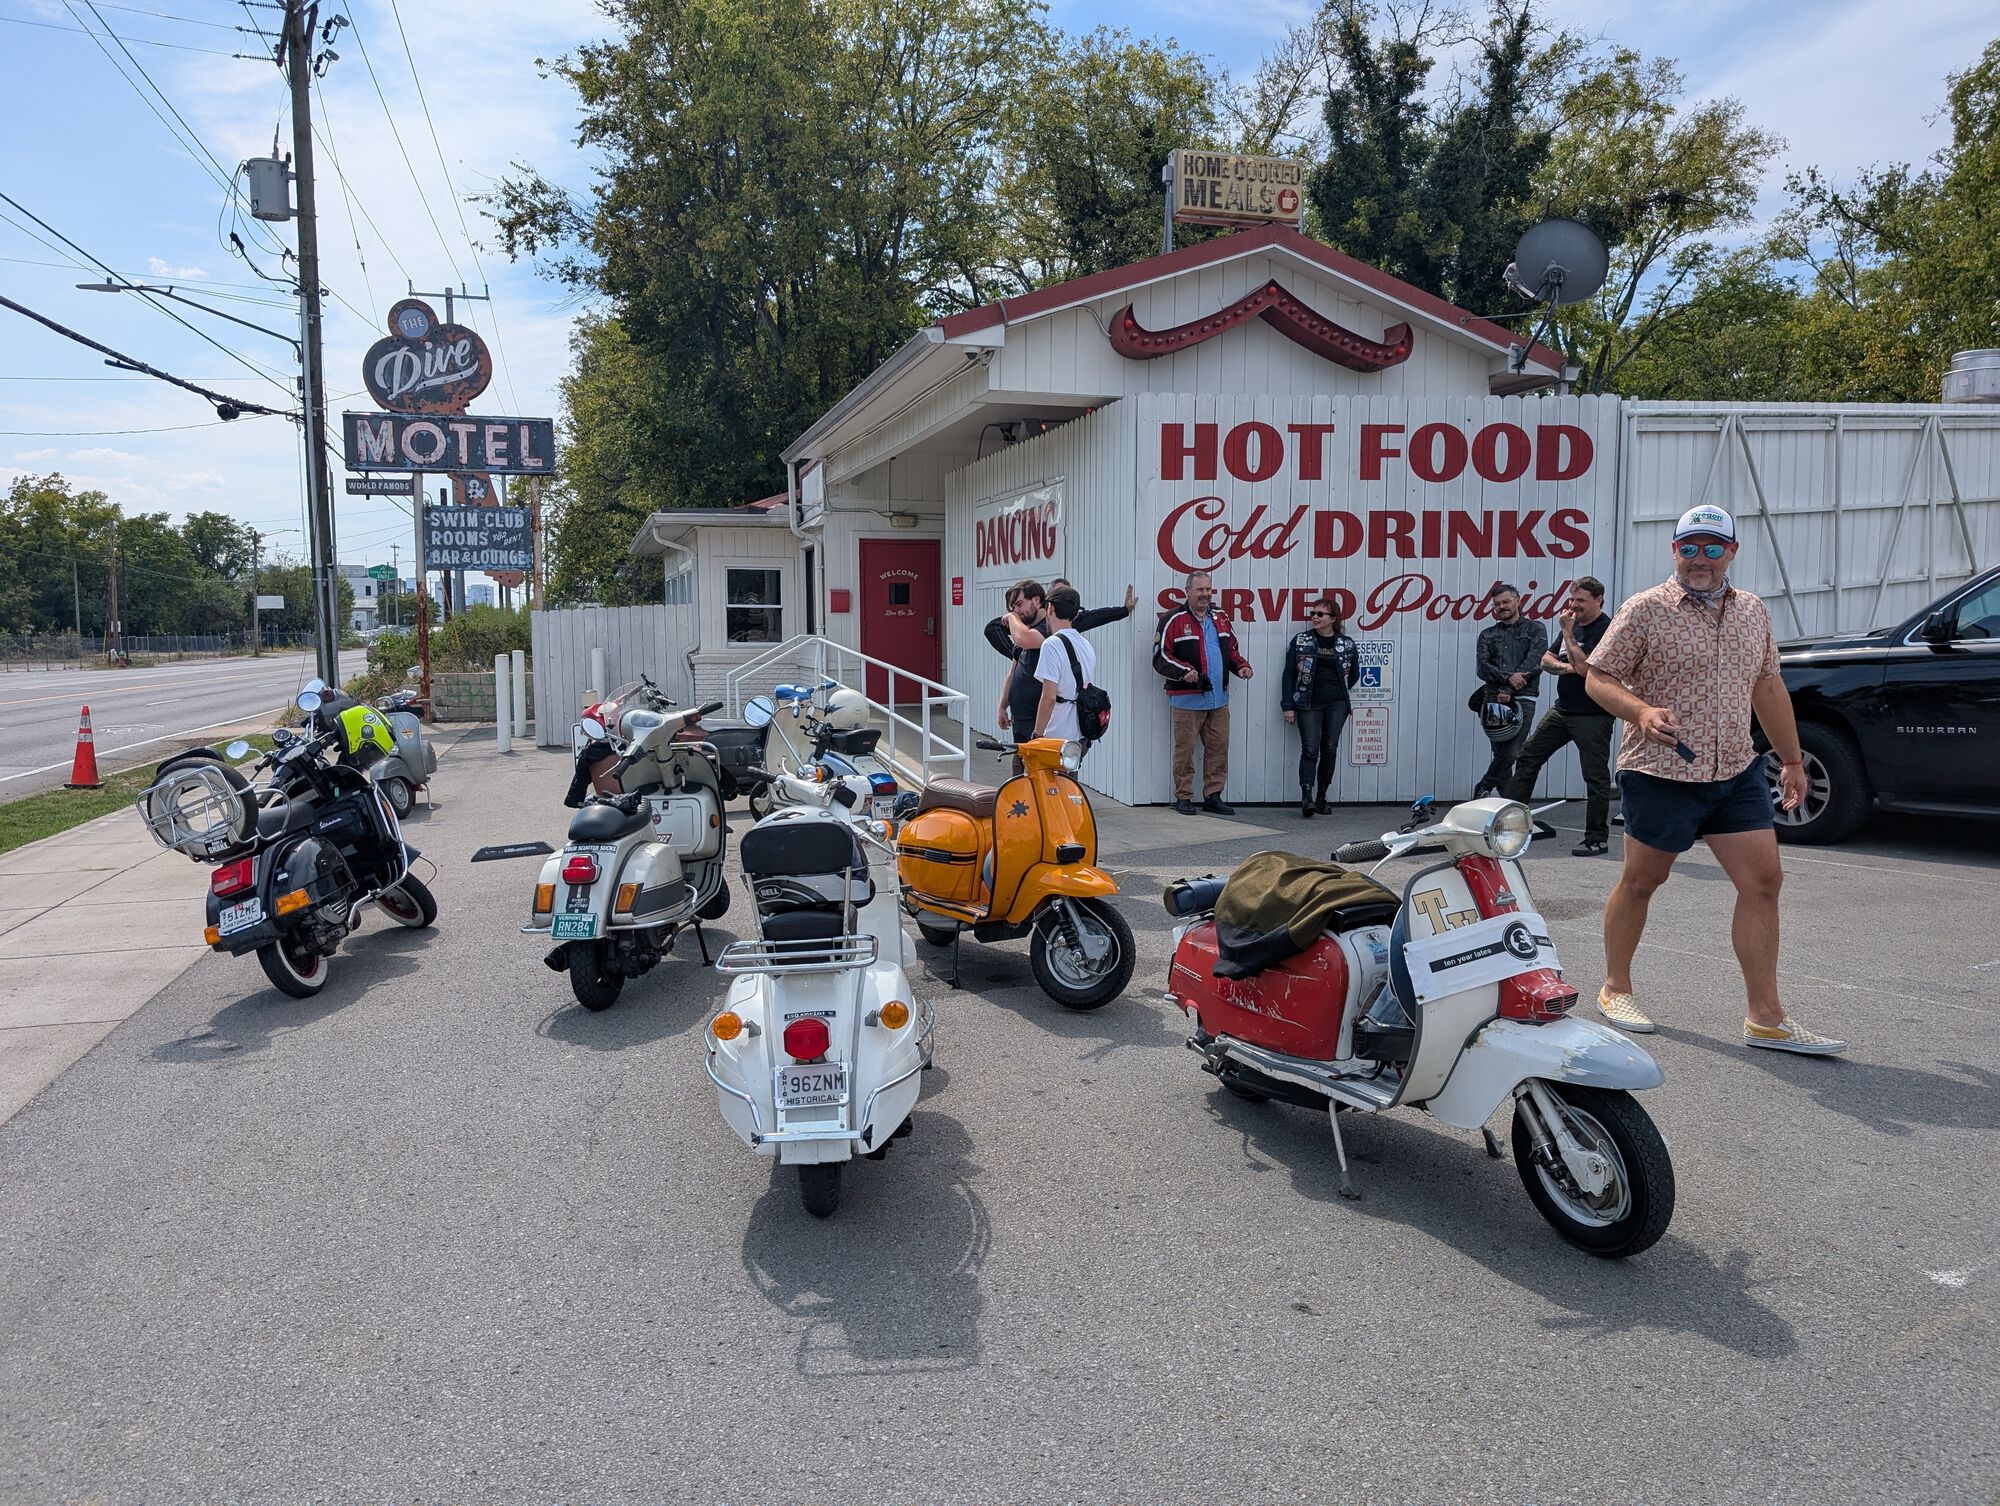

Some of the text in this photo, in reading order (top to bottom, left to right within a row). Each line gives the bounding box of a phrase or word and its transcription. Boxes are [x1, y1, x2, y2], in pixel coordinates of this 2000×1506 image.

[1183, 154, 1301, 186] HOME COOKED
[1184, 178, 1276, 214] MEALS
[401, 316, 425, 330] THE
[374, 338, 479, 400] Dive
[356, 419, 543, 467] MOTEL
[1160, 420, 1594, 483] HOT FOOD
[430, 512, 524, 529] SWIM CLUB
[431, 531, 488, 546] ROOMS
[976, 500, 1057, 568] DANCING
[1156, 496, 1590, 574] Cold DRINKS
[432, 549, 459, 564] BAR
[880, 569, 919, 580] WELCOME
[1156, 573, 1576, 631] SRVED Poolid
[1356, 643, 1393, 654] ESERVED
[1358, 655, 1389, 666] ARKING
[1896, 726, 1977, 734] SUBURBAN
[207, 842, 231, 854] SNAKE
[760, 888, 780, 896] BELL
[558, 921, 590, 932] RN284
[1443, 948, 1492, 967] ten year lates
[791, 1074, 844, 1093] 96ZNM
[786, 1095, 838, 1105] HISTORICAL
